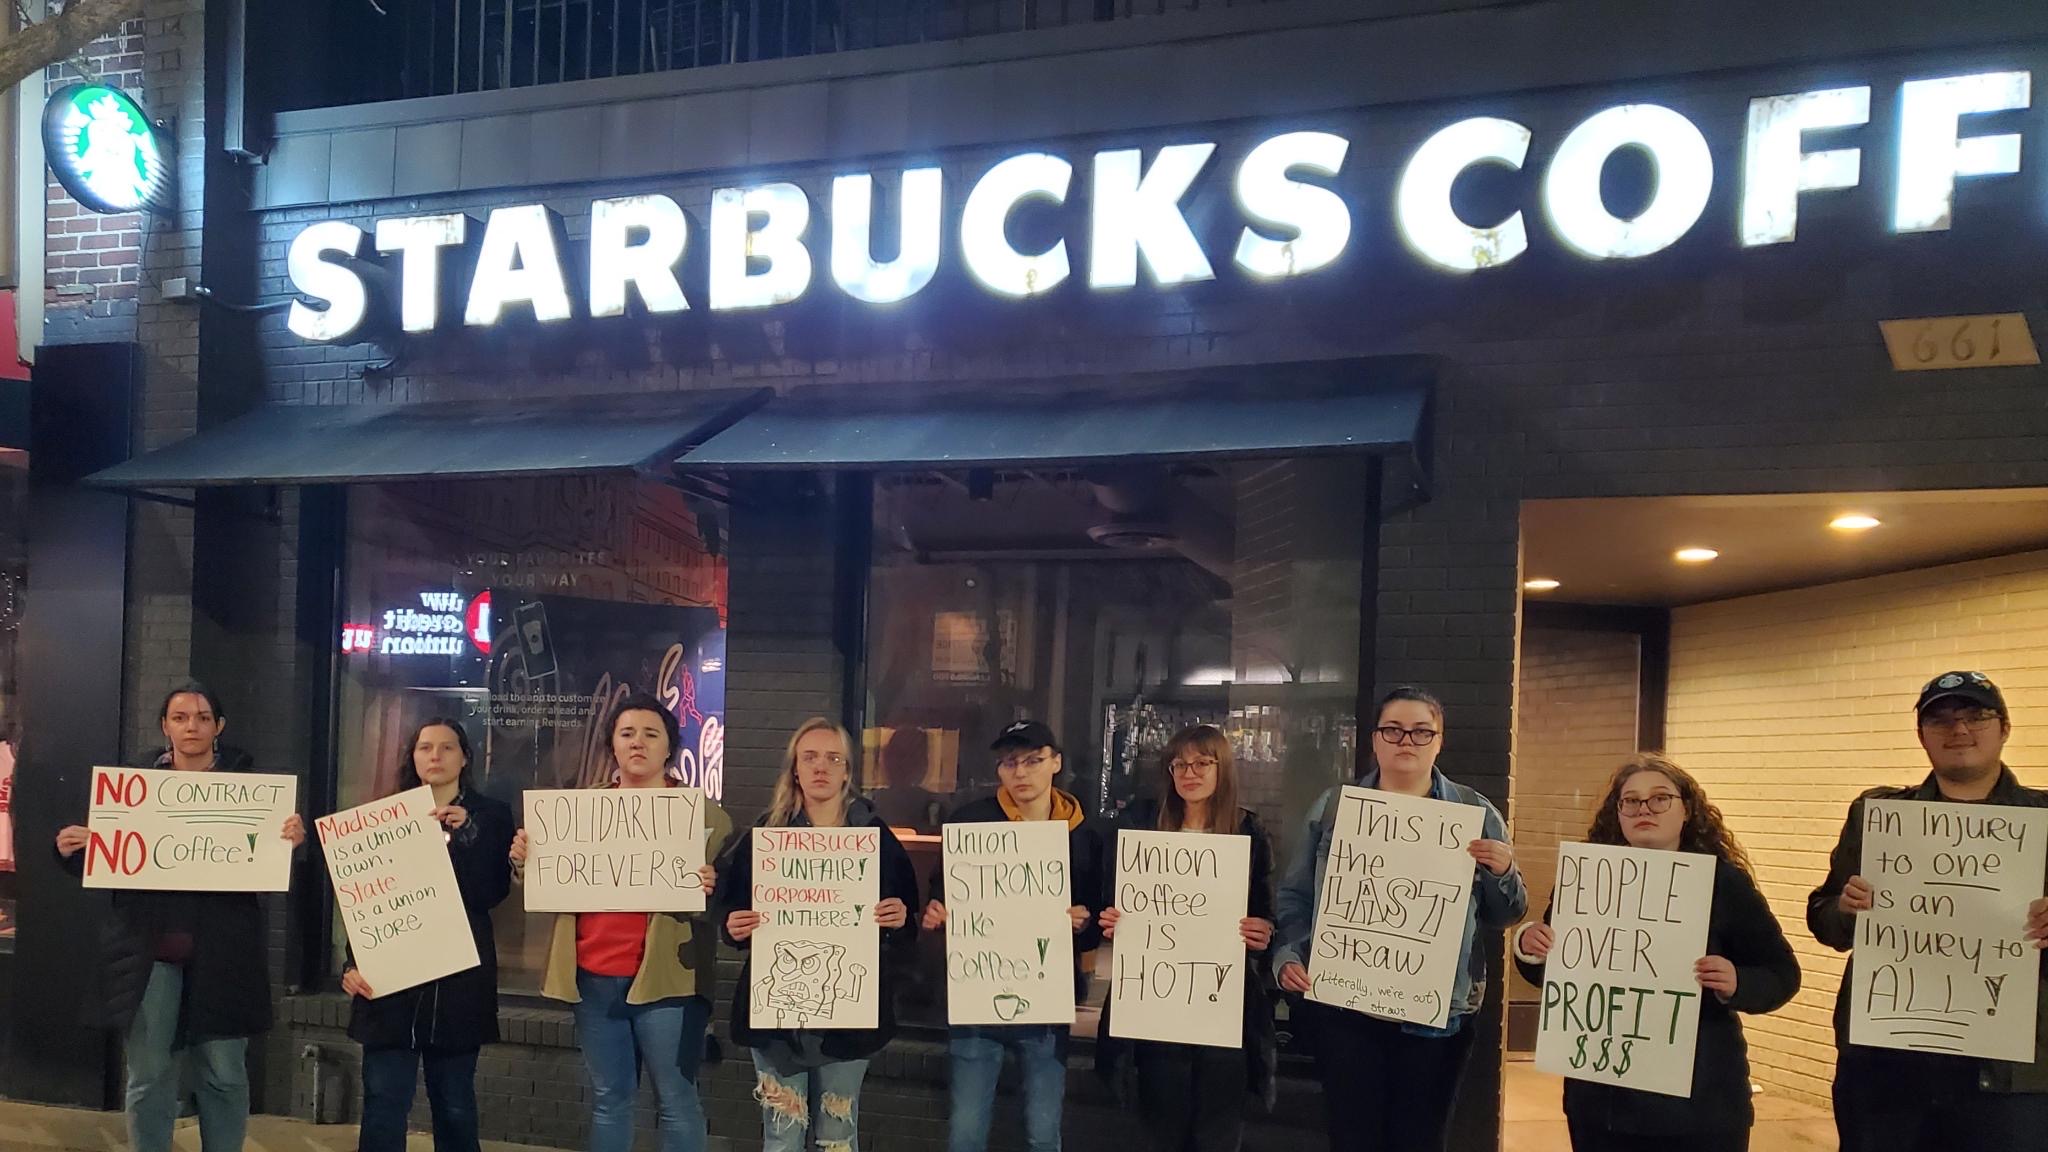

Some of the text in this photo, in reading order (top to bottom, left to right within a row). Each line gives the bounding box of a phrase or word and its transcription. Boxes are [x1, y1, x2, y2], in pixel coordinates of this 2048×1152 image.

[287, 71, 2031, 342] STARBUCKS COFF
[1912, 319, 2000, 363] 661
[491, 573, 579, 588] YOUR WAY
[521, 705, 547, 714] order
[547, 694, 557, 702] to
[559, 693, 606, 703] customze
[482, 718, 504, 727] start
[96, 772, 285, 807] NO CONTRACT
[318, 801, 408, 845] Madison
[534, 794, 699, 846] SOLIDARITY
[1344, 795, 1463, 850] This is
[1867, 805, 1902, 837] An
[86, 829, 259, 876] NO Coffee!
[352, 842, 363, 854] a
[756, 830, 877, 853] STARBUCKS
[1331, 838, 1386, 879] the
[538, 850, 673, 889] FOREVER
[762, 857, 868, 882] IS UNFAIR!
[1876, 851, 2002, 878] to one
[337, 876, 398, 909] State
[753, 884, 845, 904] CORPORATE
[1121, 882, 1208, 917] Coffee
[1323, 875, 1461, 938] LAST
[1557, 855, 1690, 924] PEOPLE
[1910, 893, 1955, 918] an
[351, 909, 366, 923] is
[372, 904, 383, 915] a
[1561, 926, 1658, 978] OVER
[1991, 938, 2024, 960] to
[1118, 953, 1233, 1005] HOT!
[1378, 985, 1404, 1000] we're
[1867, 963, 2009, 1018] ALL!
[1345, 995, 1408, 1018] of straws
[1543, 980, 1697, 1044] PROFIT
